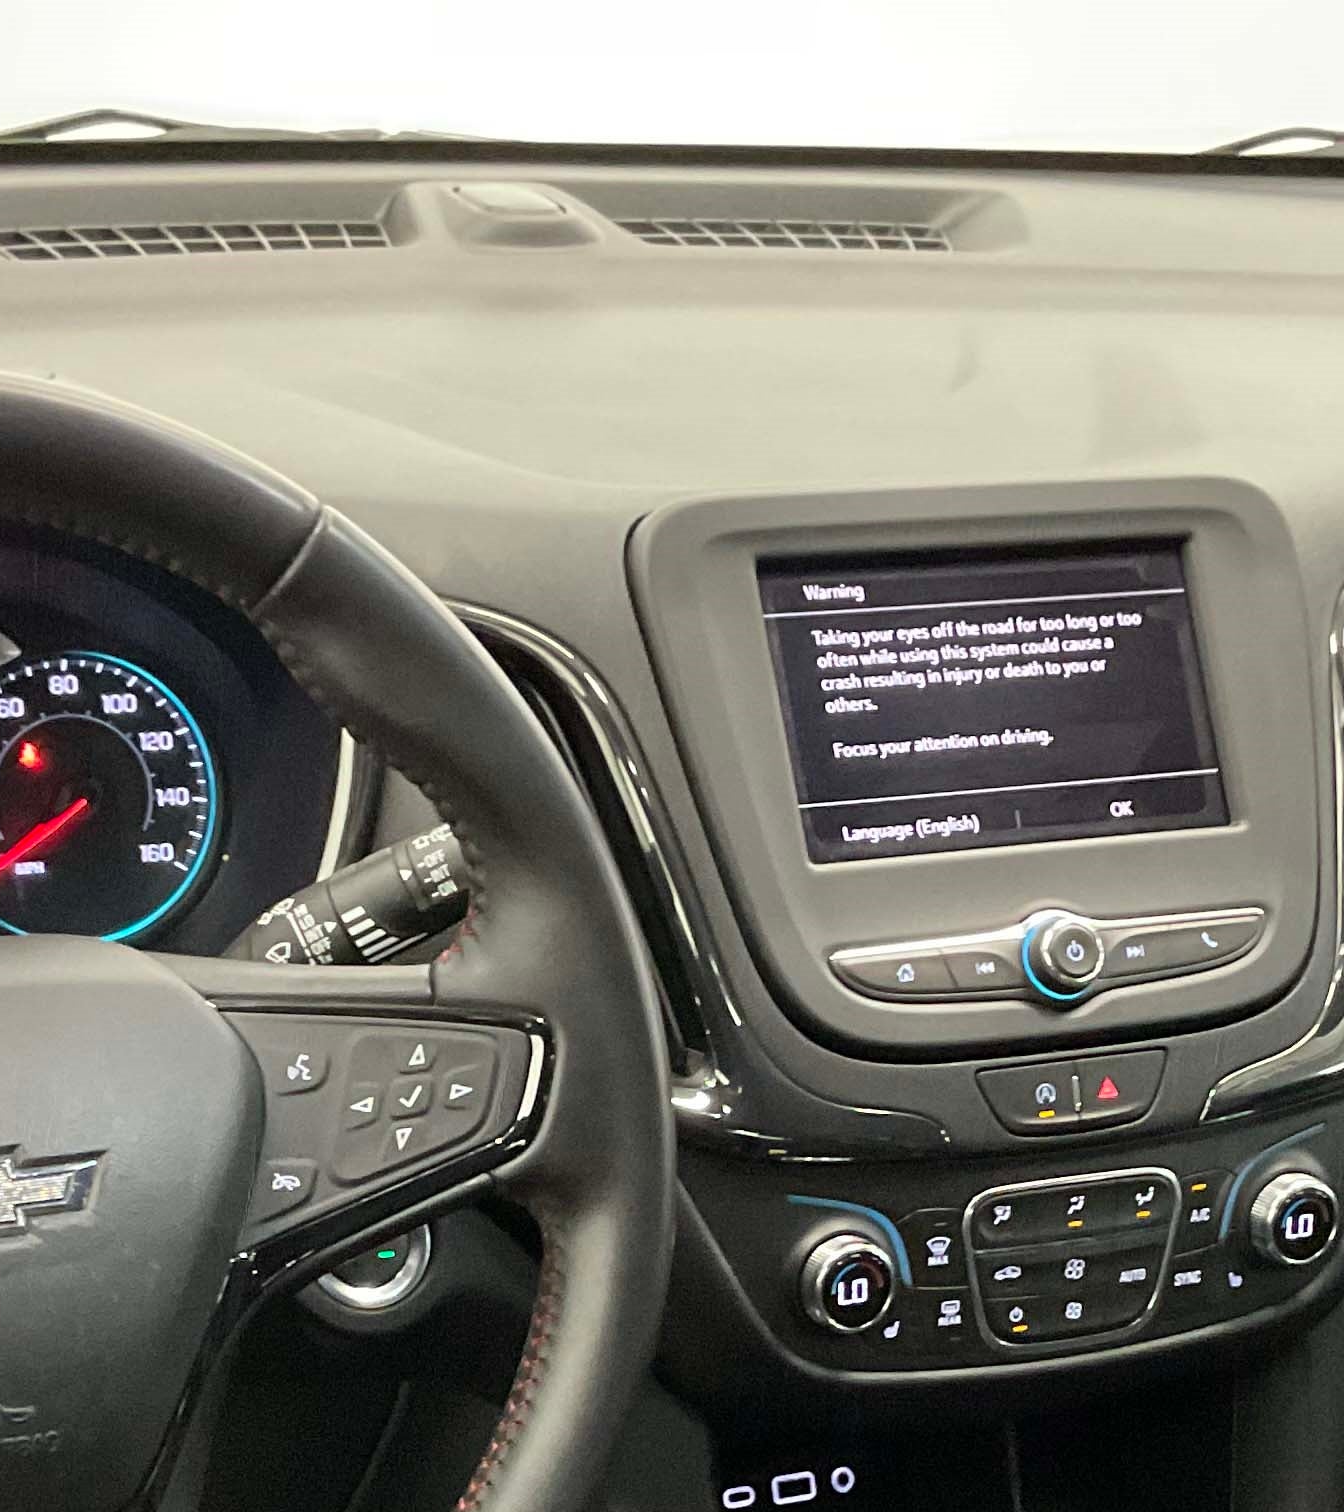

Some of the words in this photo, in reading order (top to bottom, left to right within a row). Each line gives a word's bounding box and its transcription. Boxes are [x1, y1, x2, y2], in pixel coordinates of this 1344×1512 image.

[802, 583, 865, 602] Warning
[811, 629, 860, 648] Taking
[861, 629, 894, 647] your
[896, 627, 930, 644] eyes
[931, 621, 954, 639] off
[955, 620, 981, 637] the
[982, 617, 1015, 635] road
[1016, 616, 1037, 633] for
[1040, 616, 1065, 631] too
[1065, 613, 1098, 633] long
[1099, 614, 1115, 628] or
[1116, 612, 1143, 627] too
[817, 652, 858, 669] often
[860, 648, 897, 665] while
[899, 648, 939, 665] using
[940, 644, 968, 660] this
[969, 643, 1019, 662] system
[1021, 637, 1059, 655] could
[1062, 637, 1102, 652] cause
[1104, 637, 1114, 649] a
[48, 674, 79, 695] 80
[821, 673, 862, 691] crash
[863, 670, 926, 689] resulting
[927, 669, 942, 683] in
[943, 667, 983, 685] injury
[984, 667, 1000, 680] or
[1003, 661, 1044, 678] death
[1045, 661, 1061, 675] to
[1062, 661, 1089, 679] you
[1090, 659, 1106, 672] or
[101, 693, 138, 714] 100
[825, 697, 879, 713] others.
[138, 731, 174, 751] 120
[832, 741, 878, 759] Focus
[879, 740, 911, 759] your
[914, 734, 978, 753] attention
[979, 733, 1000, 747] on
[1000, 728, 1054, 747] driving.
[156, 787, 190, 807] 140
[1109, 800, 1135, 818] OK
[842, 822, 914, 843] Language
[915, 814, 981, 839] (English)
[139, 842, 175, 862] 160
